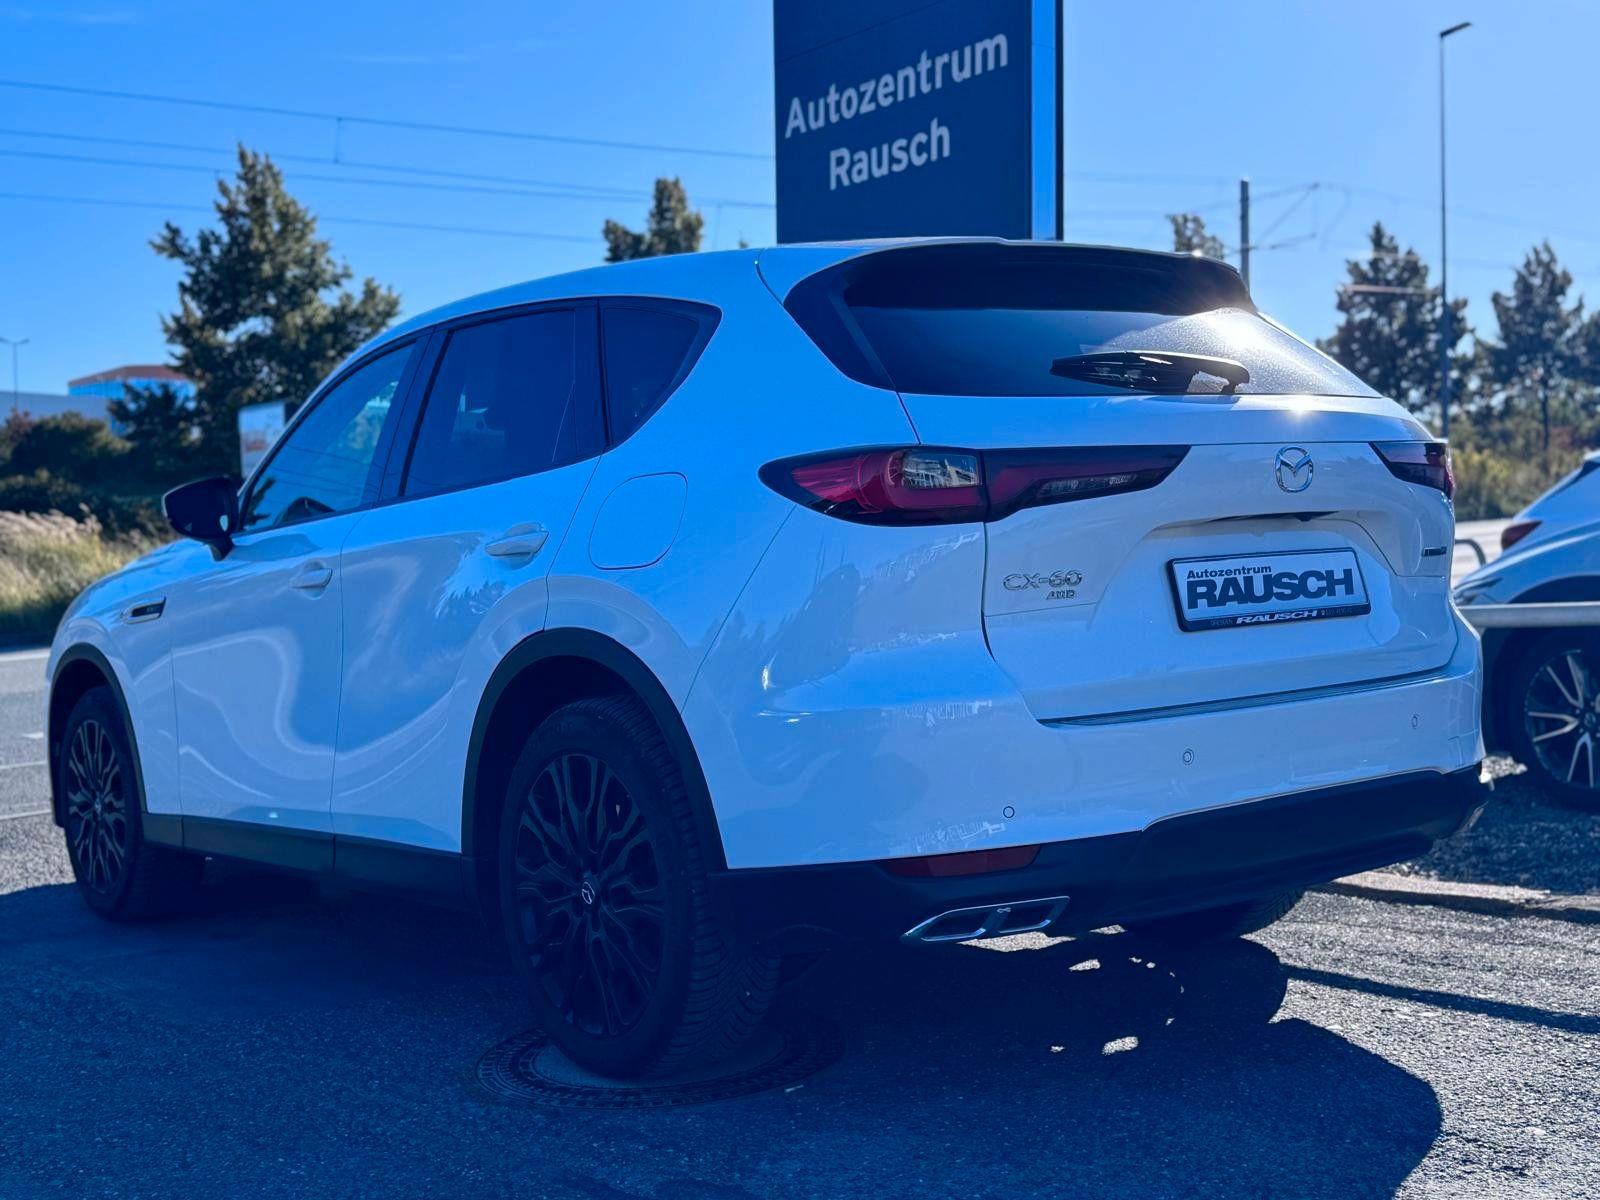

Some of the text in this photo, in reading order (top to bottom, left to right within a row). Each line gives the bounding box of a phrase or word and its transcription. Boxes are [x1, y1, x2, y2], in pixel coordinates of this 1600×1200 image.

[785, 33, 1008, 138] Autozentrum
[829, 117, 951, 190] Rausch
[1003, 570, 1082, 590] CX-60
[1187, 566, 1271, 579] Autozentrum
[1187, 568, 1354, 609] RAUSCH
[1236, 610, 1318, 624] RAUSCH
